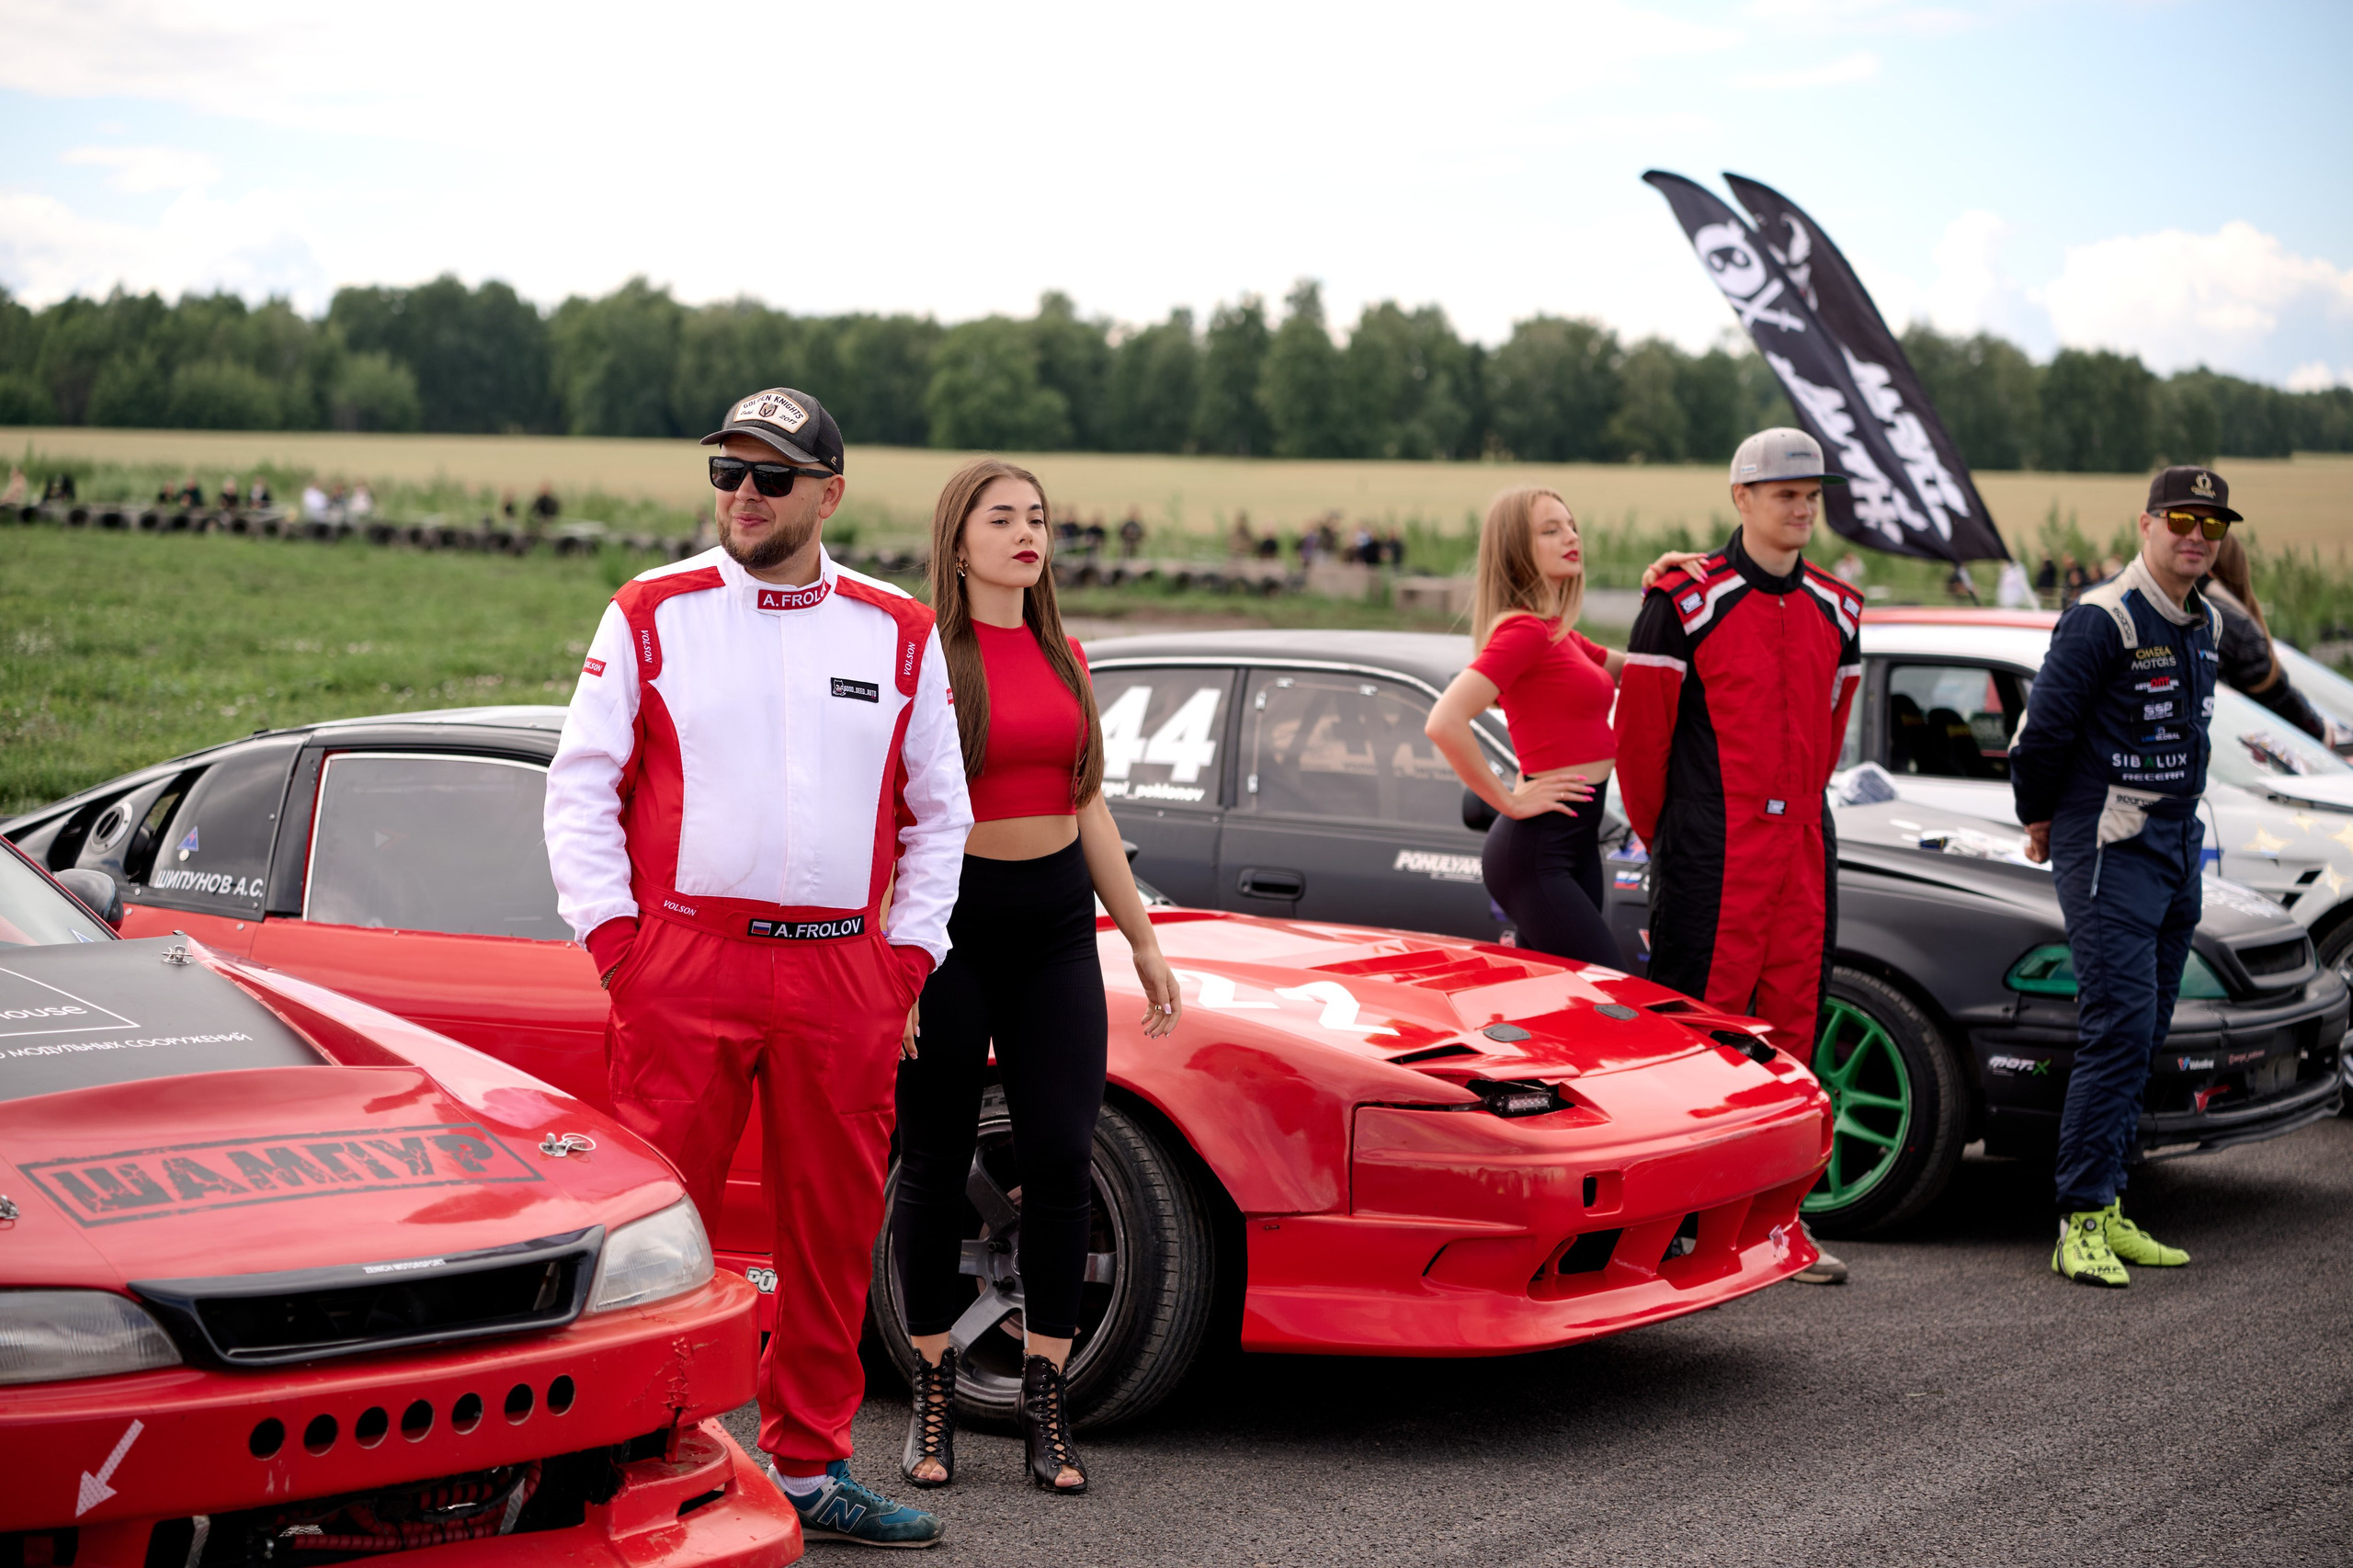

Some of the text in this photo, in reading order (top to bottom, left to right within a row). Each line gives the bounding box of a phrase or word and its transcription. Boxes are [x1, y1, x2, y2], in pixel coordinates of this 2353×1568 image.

[743, 394, 804, 420] GOLDEN KNIGHTS
[779, 414, 798, 425] 2017
[641, 630, 653, 664] VOLSON
[2135, 646, 2172, 660] OMEGA
[904, 642, 916, 676] VOLSON
[2131, 655, 2177, 671] MOTORS
[2143, 701, 2173, 717] SSP
[1100, 686, 1222, 783] 44
[2112, 753, 2188, 768] SIBALUX
[153, 869, 233, 894] ШИПУНОВ
[663, 899, 697, 917] VOLSON
[774, 917, 862, 939] A.FROLOV
[7, 1031, 254, 1058] МОДУЛЬНЫХ СООРУЖЕНИЙ
[50, 1134, 494, 1213] ШАМПУР
